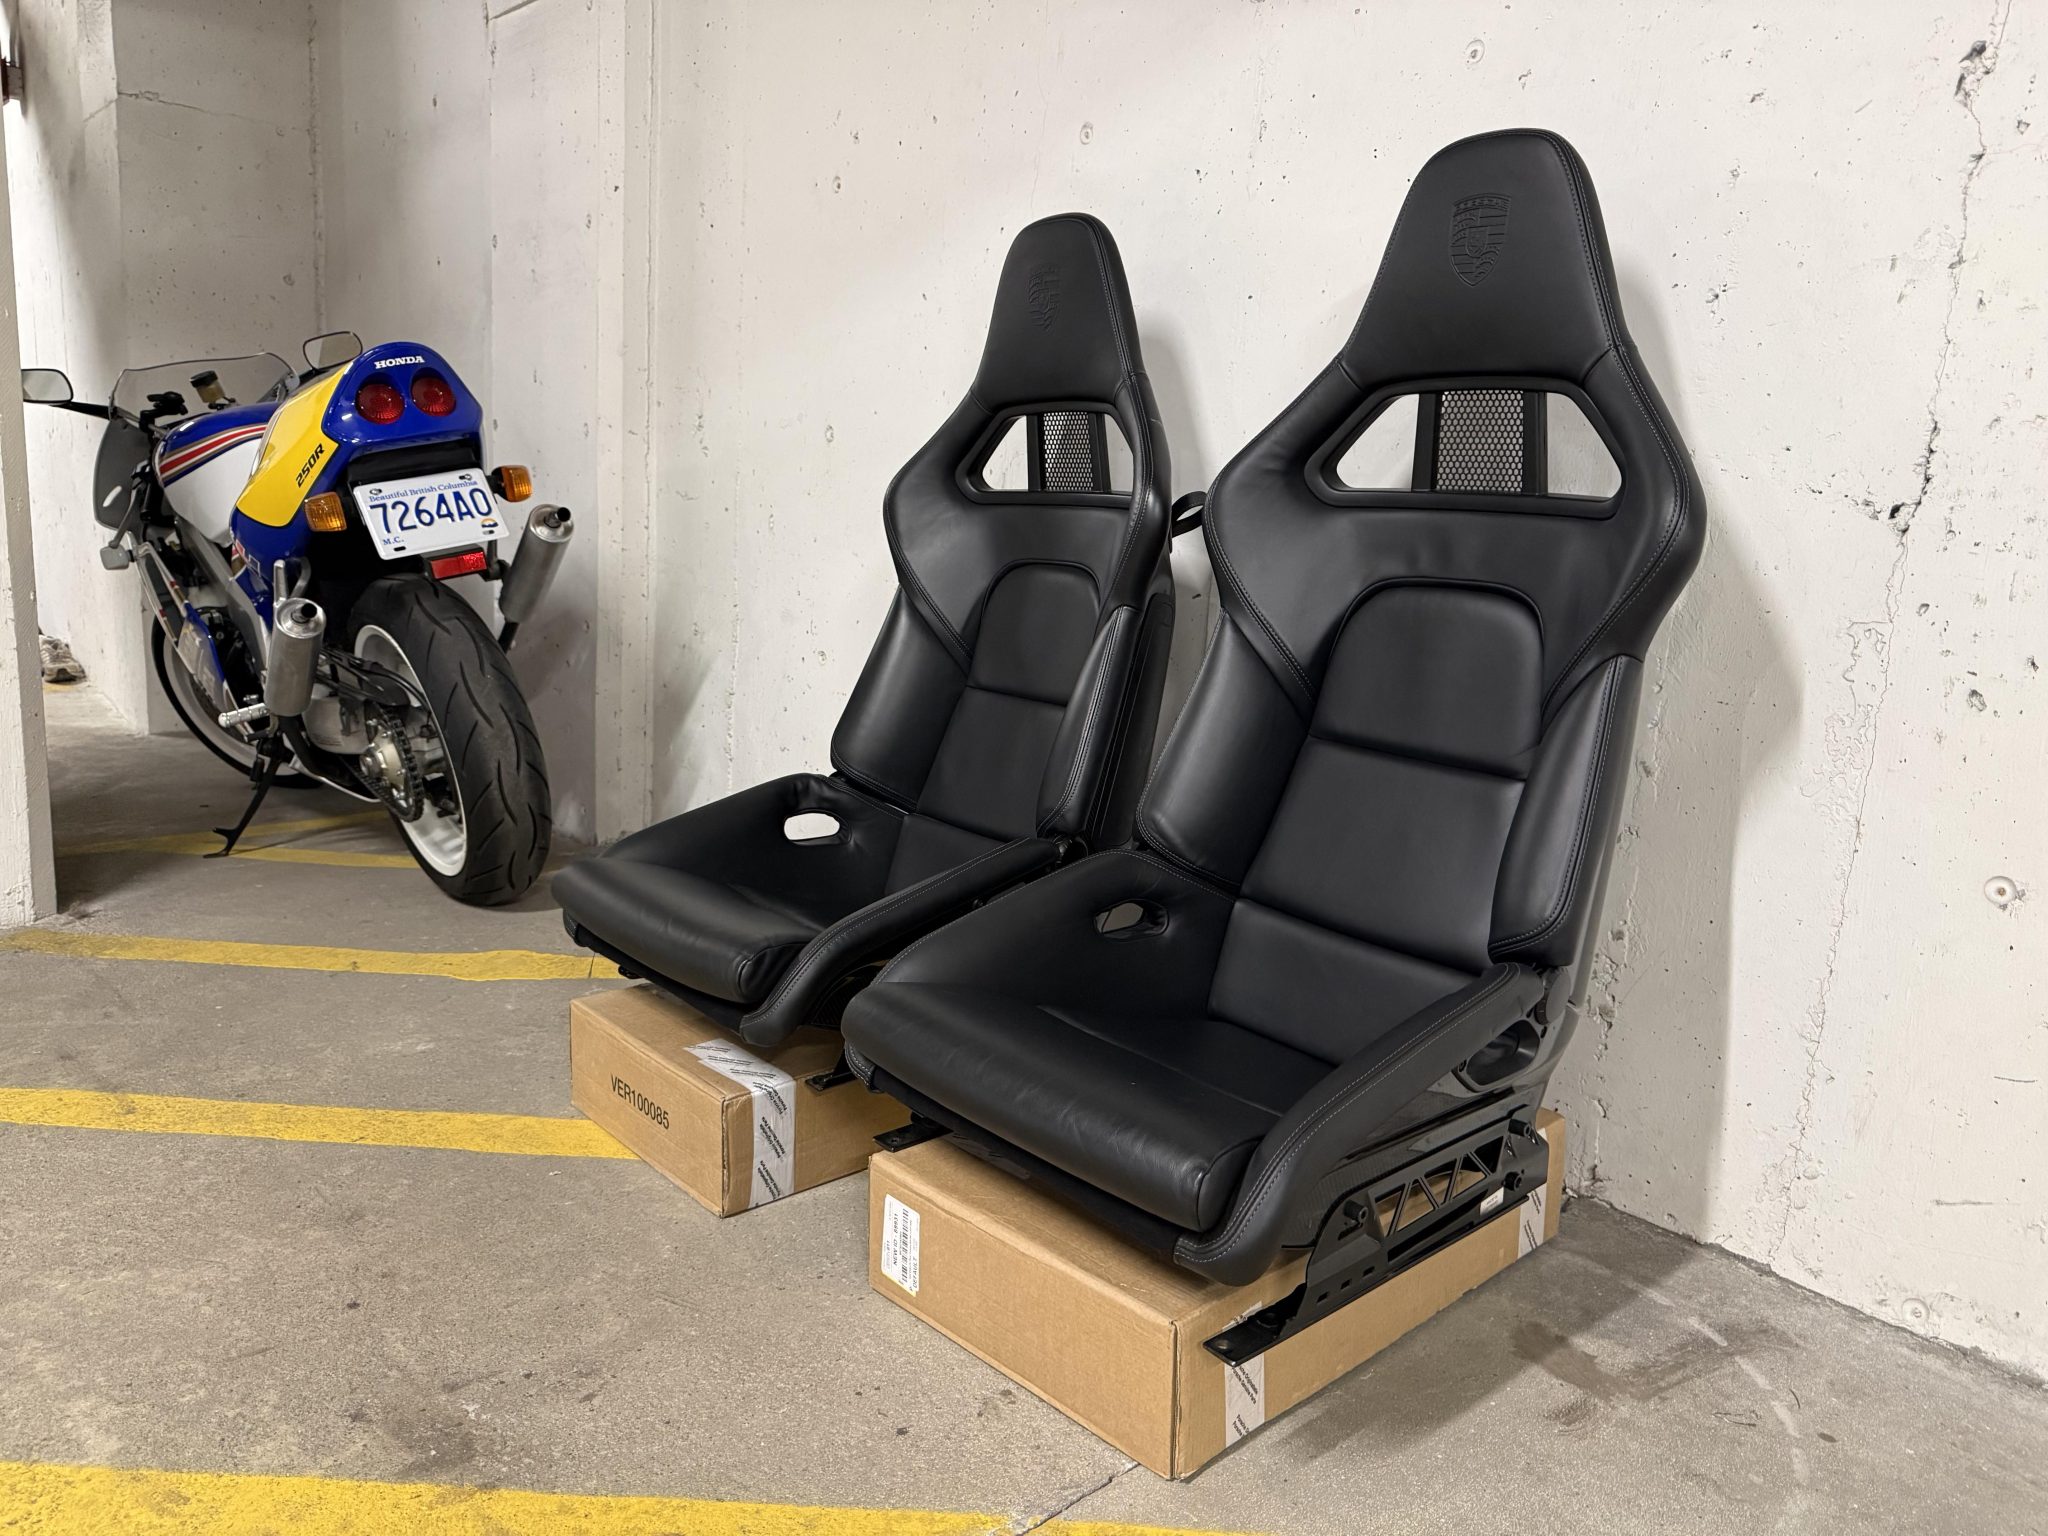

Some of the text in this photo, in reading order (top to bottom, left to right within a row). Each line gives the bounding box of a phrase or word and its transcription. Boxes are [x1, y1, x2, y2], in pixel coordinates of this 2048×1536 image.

[374, 356, 425, 369] HONDA
[296, 443, 325, 488] 250R
[369, 480, 478, 502] Beautiful British Columbia
[383, 536, 404, 545] M.C.
[611, 1072, 669, 1130] VER100085
